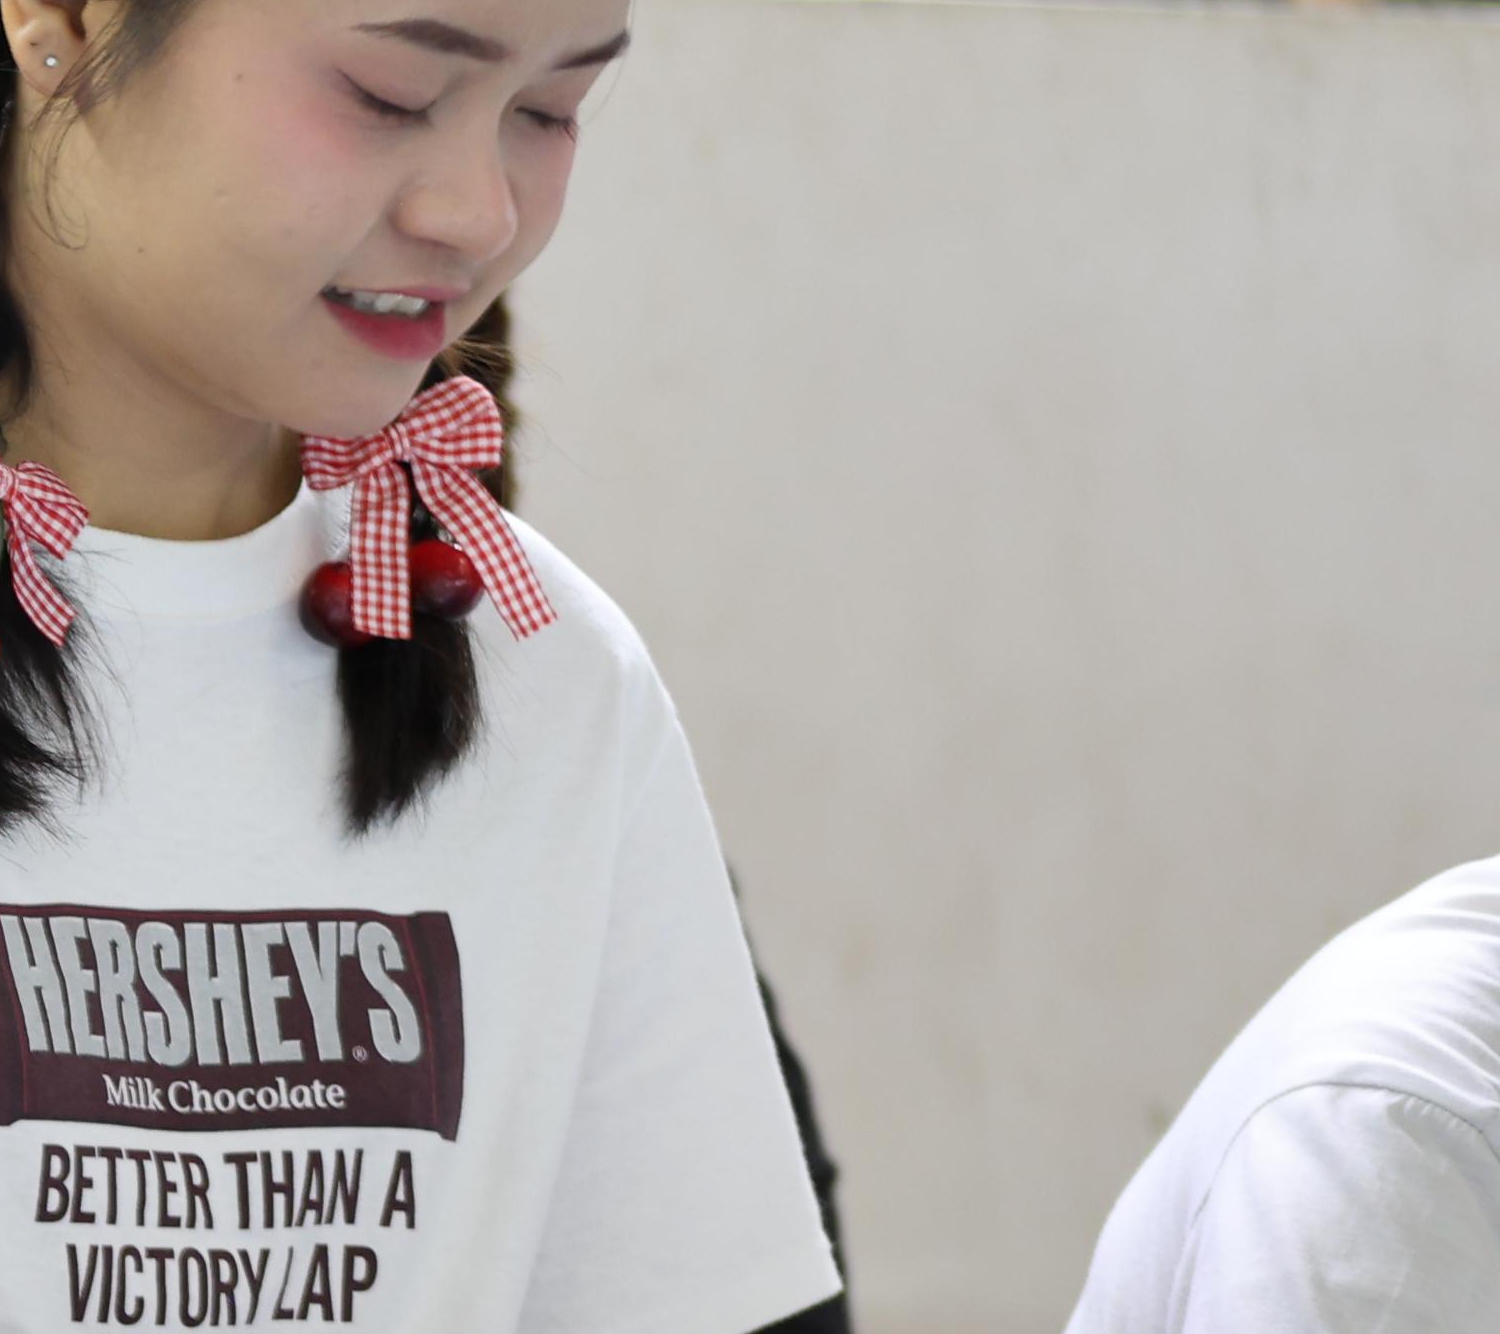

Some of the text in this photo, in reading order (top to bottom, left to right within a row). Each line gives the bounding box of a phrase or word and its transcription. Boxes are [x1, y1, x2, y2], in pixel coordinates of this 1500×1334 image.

[0, 914, 425, 1067] HERSHEY'S
[101, 1073, 347, 1115] Milk Chocolate
[34, 1142, 418, 1230] BETTER THAN A
[65, 1242, 379, 1328] VICTORY LAP
